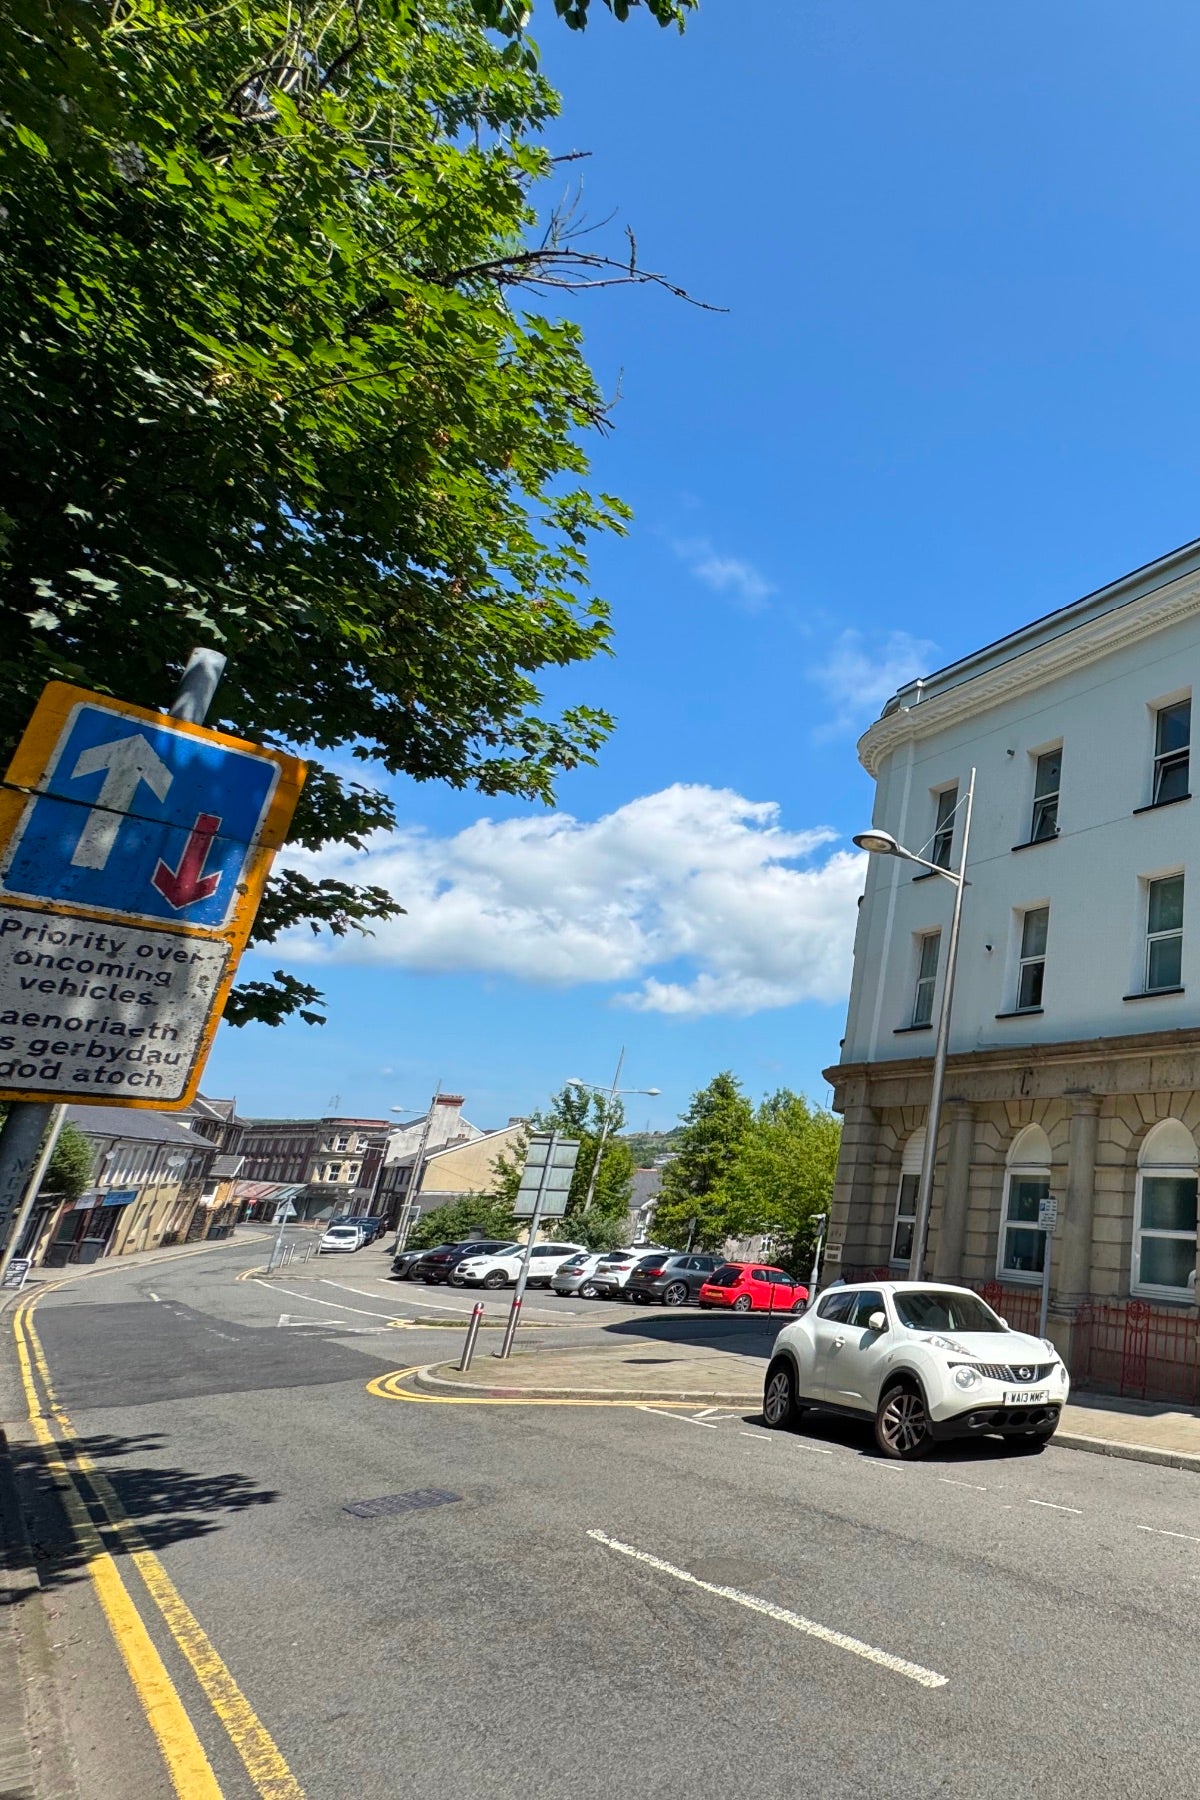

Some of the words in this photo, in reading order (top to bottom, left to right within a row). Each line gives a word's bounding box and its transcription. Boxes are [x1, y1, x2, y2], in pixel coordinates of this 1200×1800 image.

[0, 918, 126, 957] Priority
[136, 943, 203, 965] over
[13, 950, 172, 987] oncoming
[19, 976, 155, 1005] vehicles
[27, 1039, 180, 1066] gerbydau
[72, 1065, 163, 1088] atoch
[1011, 1392, 1029, 1403] WA13
